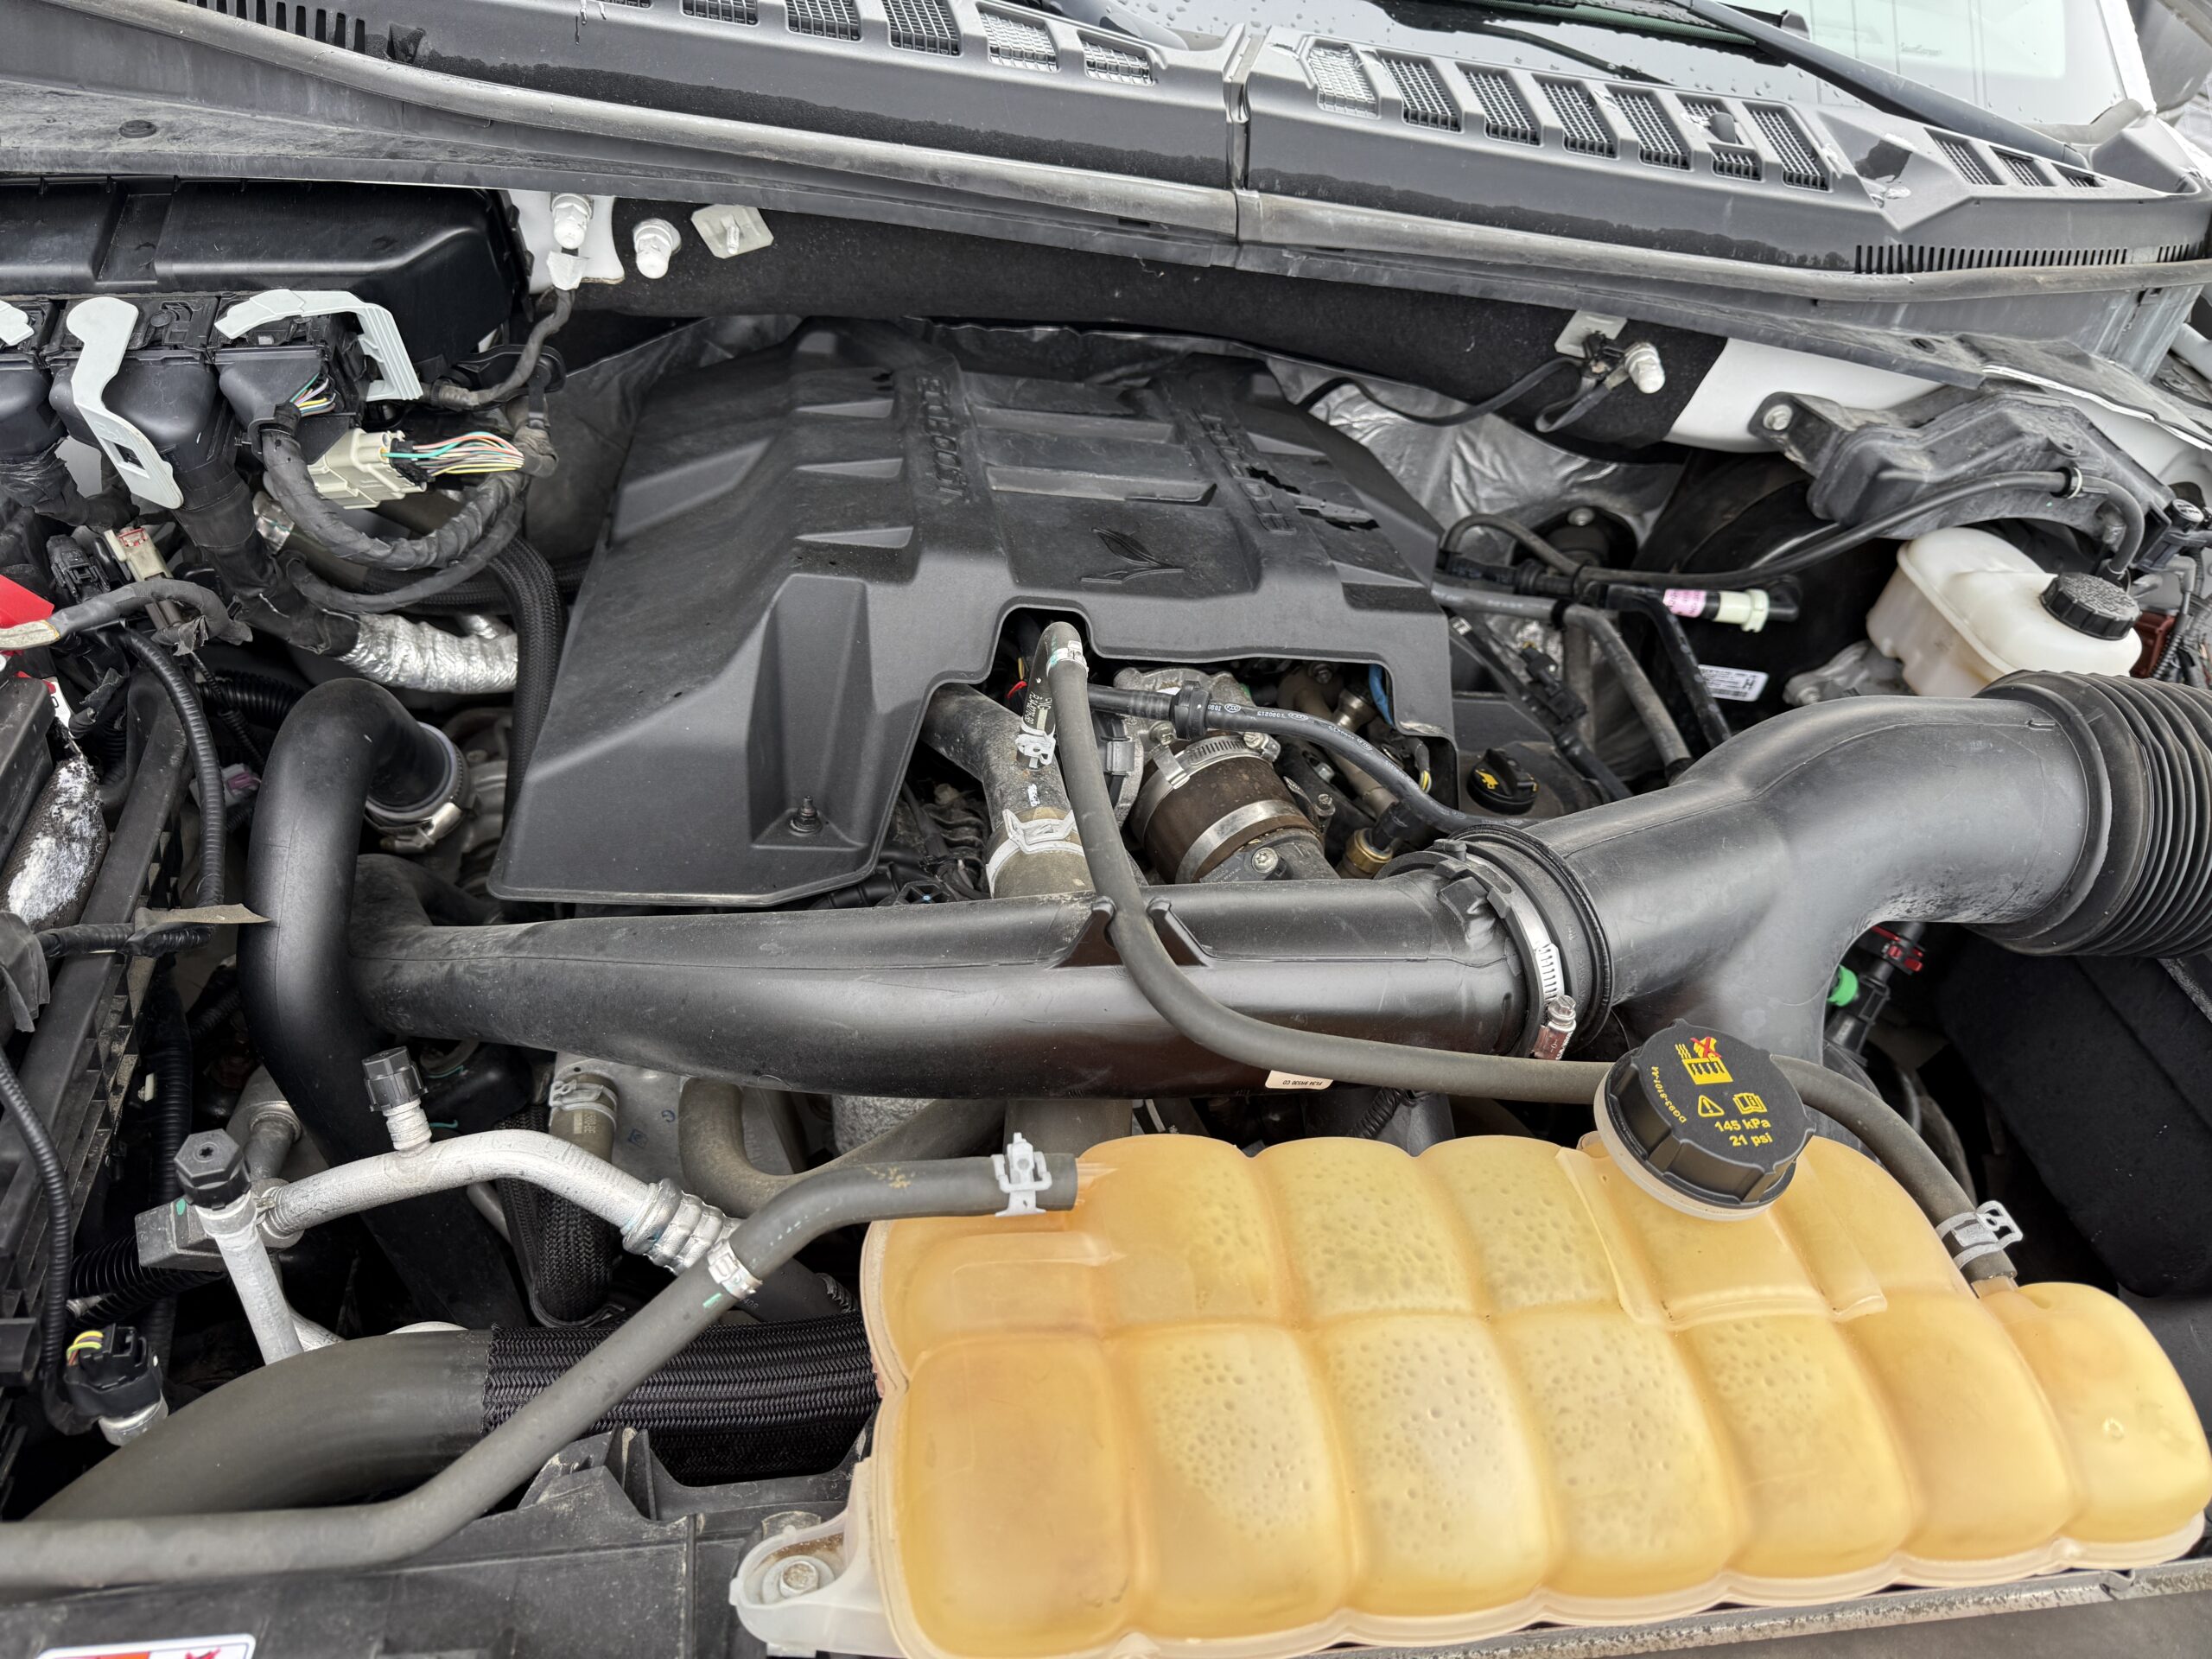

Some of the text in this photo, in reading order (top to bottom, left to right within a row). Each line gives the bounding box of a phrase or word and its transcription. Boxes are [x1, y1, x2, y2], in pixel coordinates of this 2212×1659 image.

[1714, 1118, 1771, 1133] 145 kPa
[1729, 1132, 1773, 1147] 21 psi
